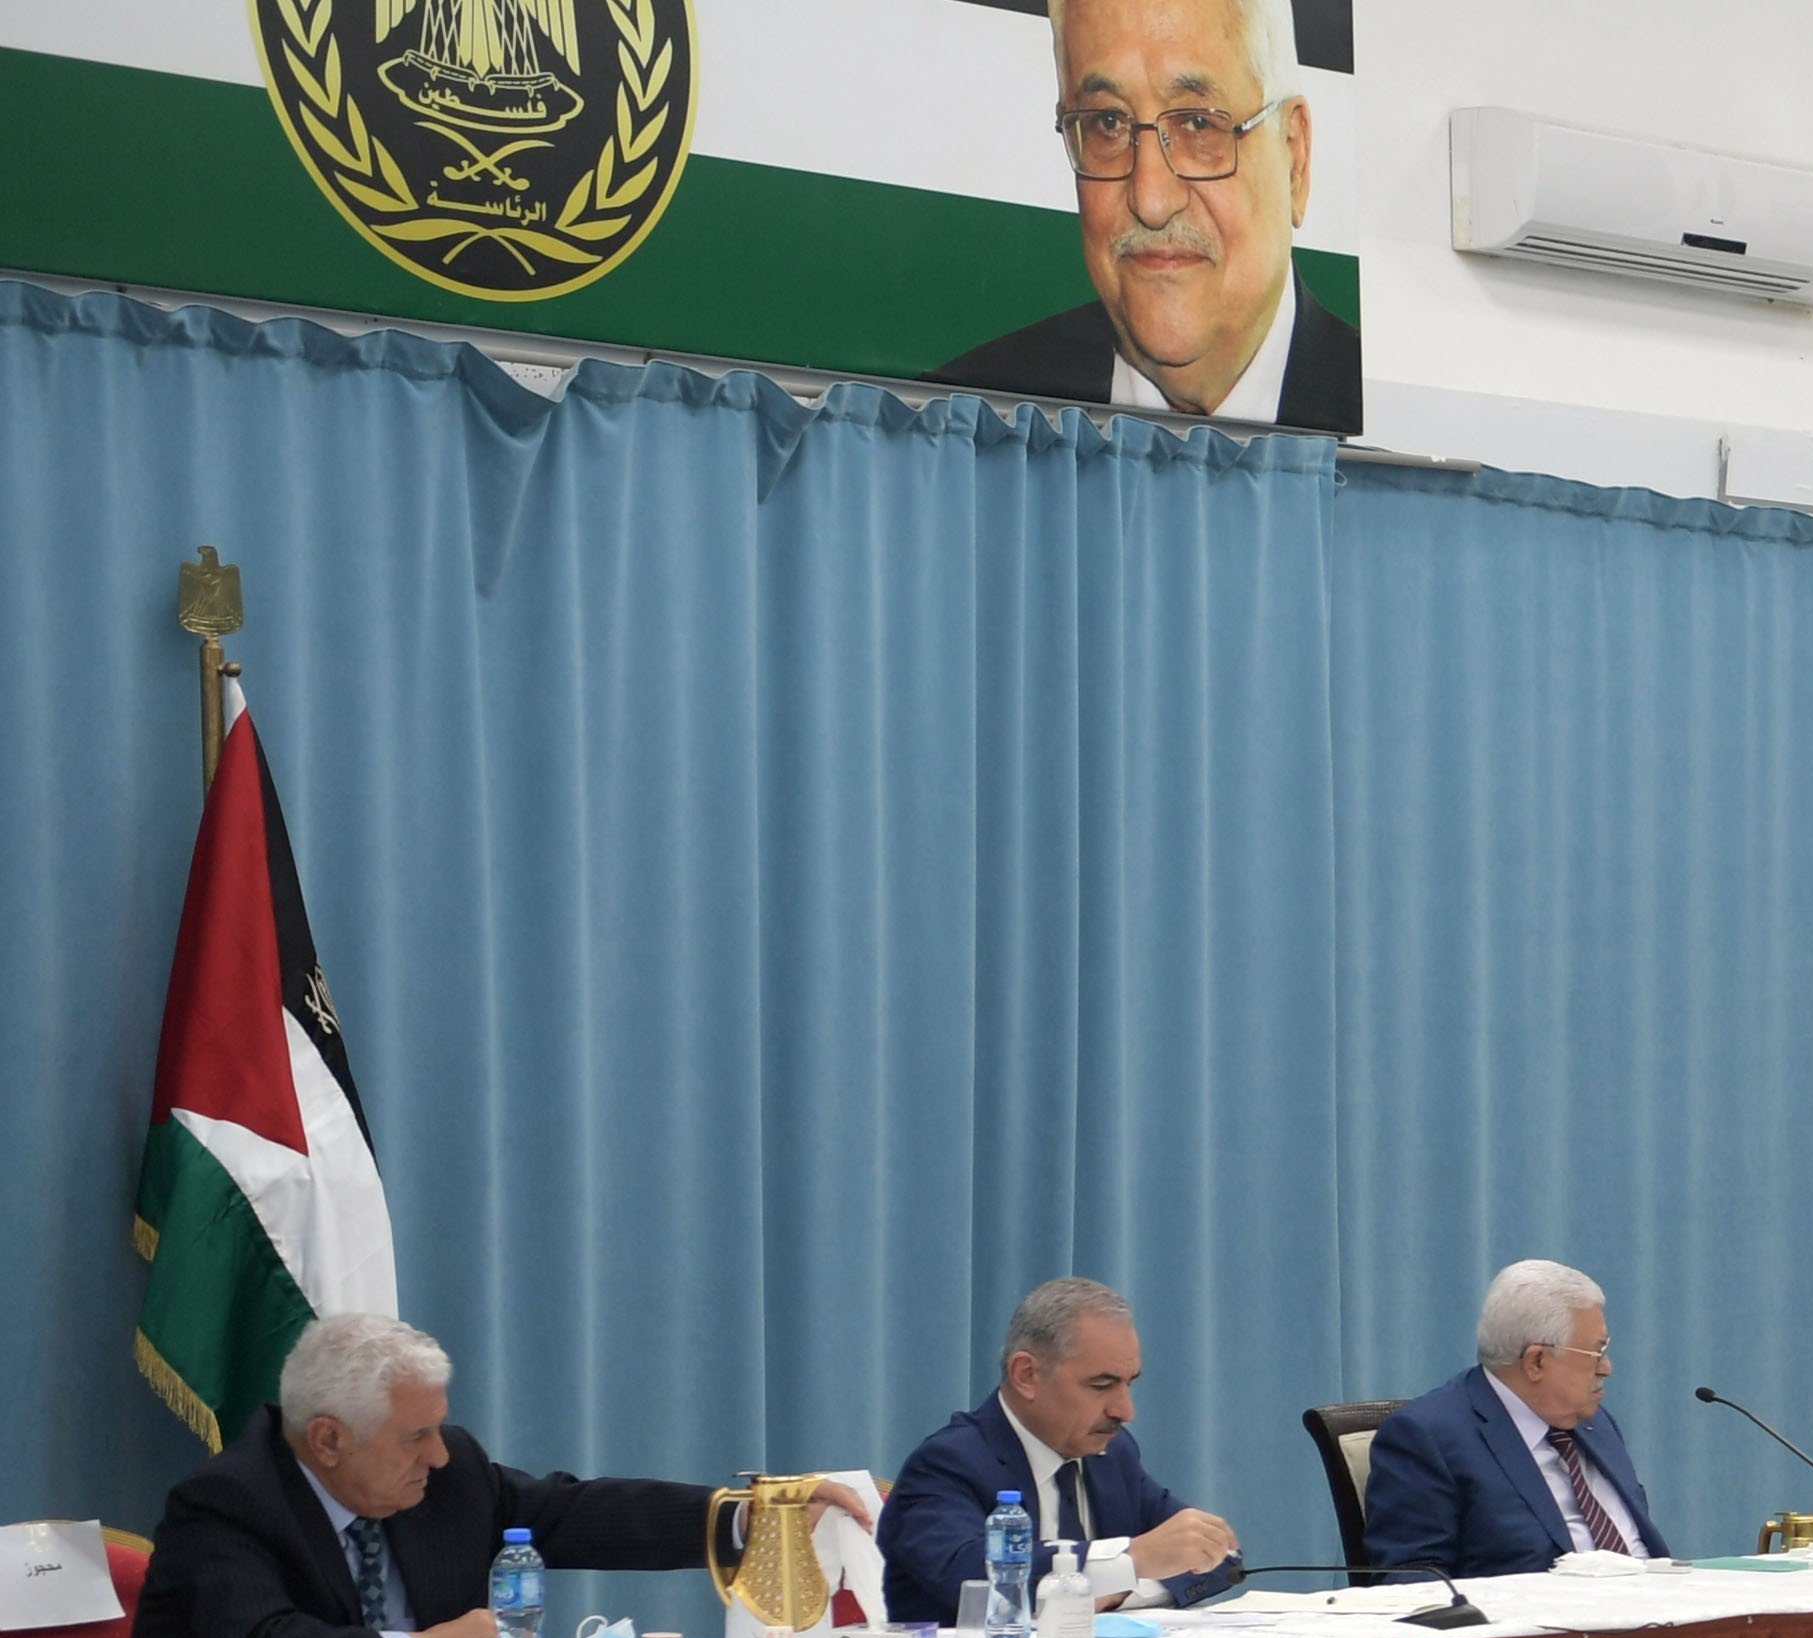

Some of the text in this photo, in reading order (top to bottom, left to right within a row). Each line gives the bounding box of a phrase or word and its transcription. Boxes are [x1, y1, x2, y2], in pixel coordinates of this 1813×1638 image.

[418, 81, 548, 120] فلسطين
[426, 181, 547, 223] الرئاسة
[24, 1561, 63, 1578] محجوز
